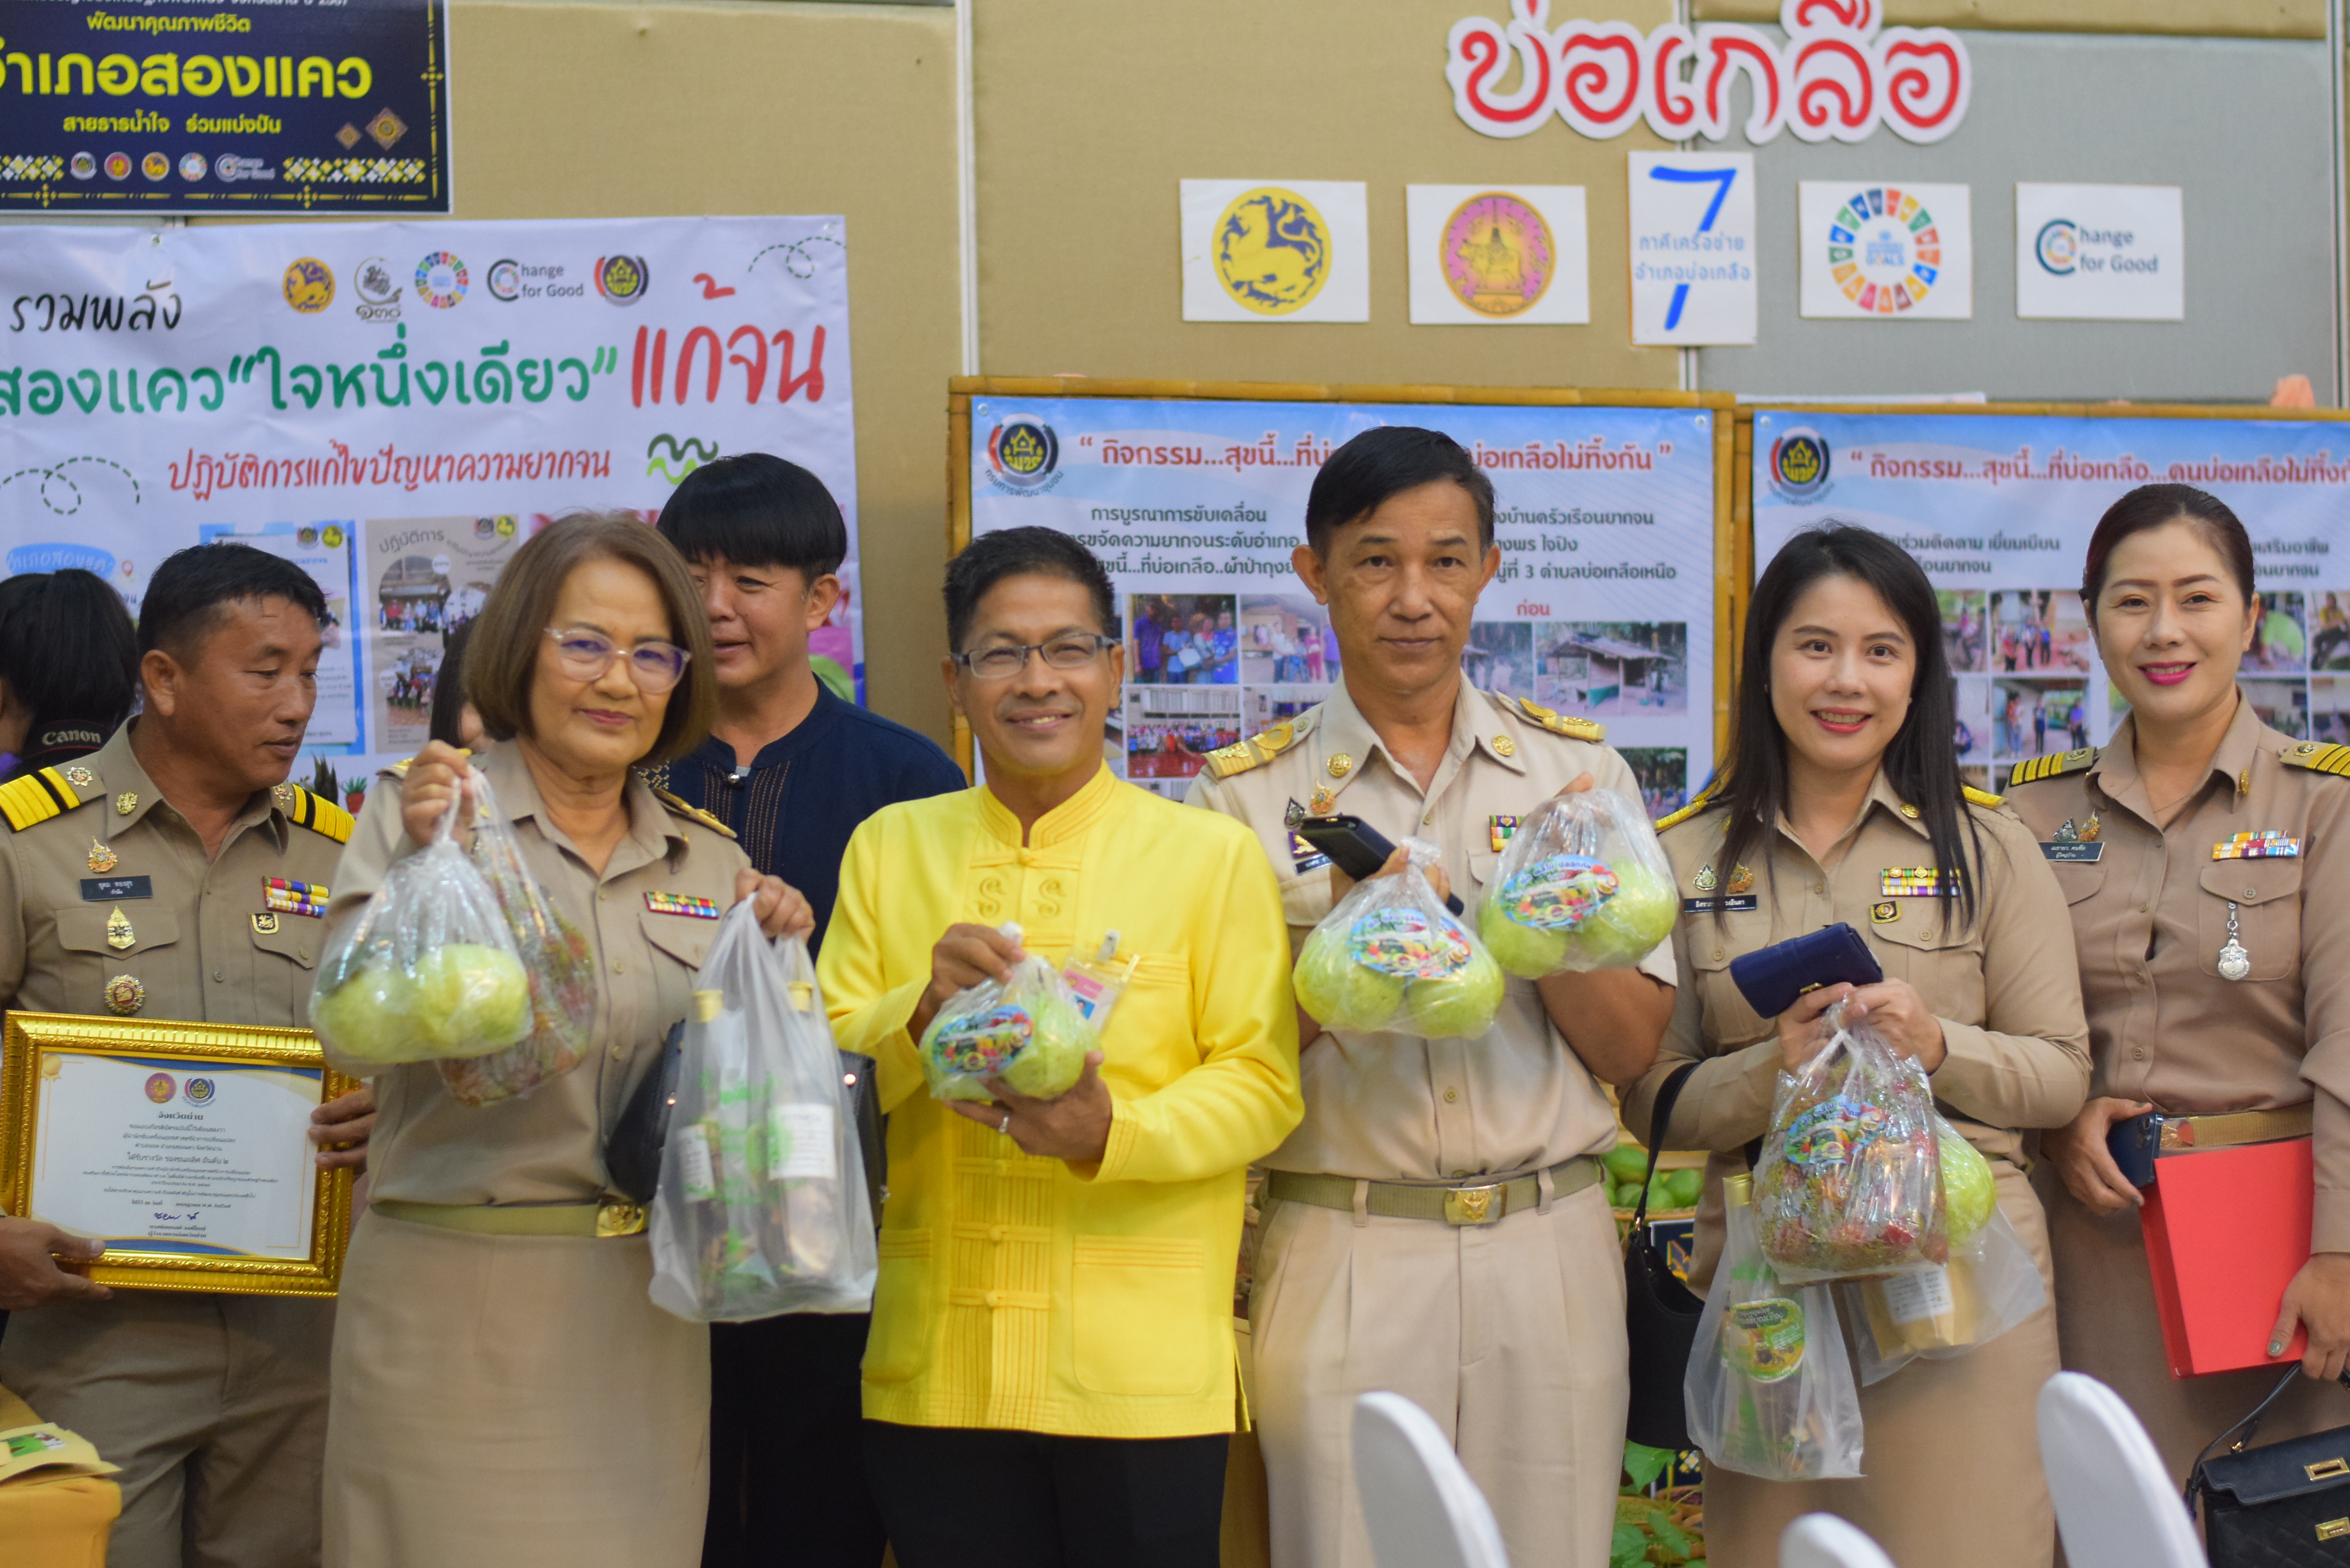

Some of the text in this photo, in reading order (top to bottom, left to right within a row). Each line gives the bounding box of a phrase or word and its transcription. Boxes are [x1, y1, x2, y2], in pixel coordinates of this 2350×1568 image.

[87, 11, 251, 36] พัฒนาคุณภาพชีวิต
[0, 37, 372, 99] ำเภอสองแคว
[63, 109, 282, 134] สายธารน้ำใจ ร่วมแบ่งปัน
[1635, 262, 1750, 281] อำเภอบ่อเกลือ
[2080, 255, 2158, 273] for Good
[522, 283, 584, 297] for Good
[9, 280, 182, 332] รวมพลัง
[631, 273, 826, 408] แก้จน
[169, 440, 610, 500] ปฏิบัติการแก้ไขปัญหาความยากจน
[1091, 502, 1267, 525] การบูรณาการขับเคลื่อน
[1494, 558, 1677, 583] มู่ที่ 3 ตำบลบ่อเกลือเหนือ
[1517, 599, 1550, 616] ก่อน
[42, 729, 101, 746] Canon
[158, 1111, 204, 1121] จังหวัดน่าน
